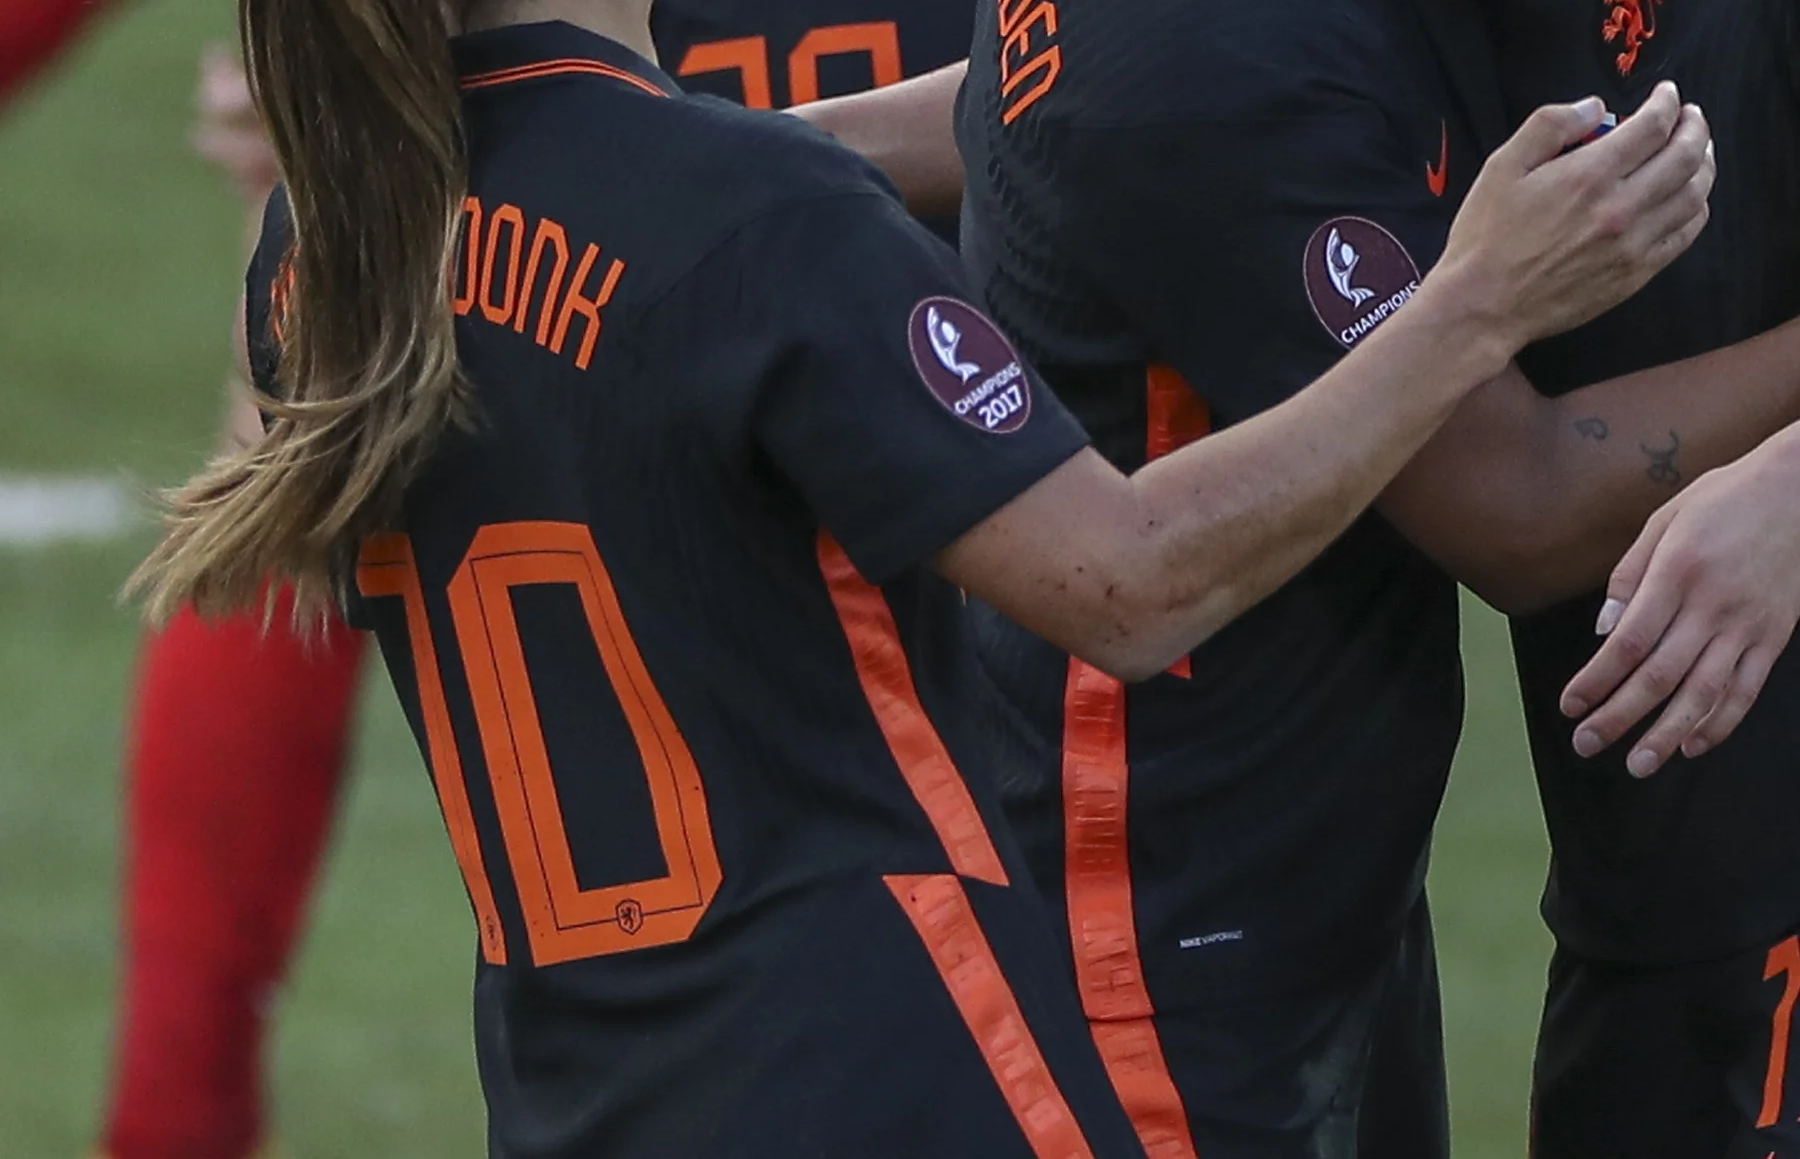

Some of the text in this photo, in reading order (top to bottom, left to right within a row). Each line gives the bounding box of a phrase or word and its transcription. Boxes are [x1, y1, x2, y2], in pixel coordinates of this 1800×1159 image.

[954, 361, 1021, 415] CHAMPIONS
[978, 384, 1023, 429] 2017
[356, 520, 724, 968] 10
